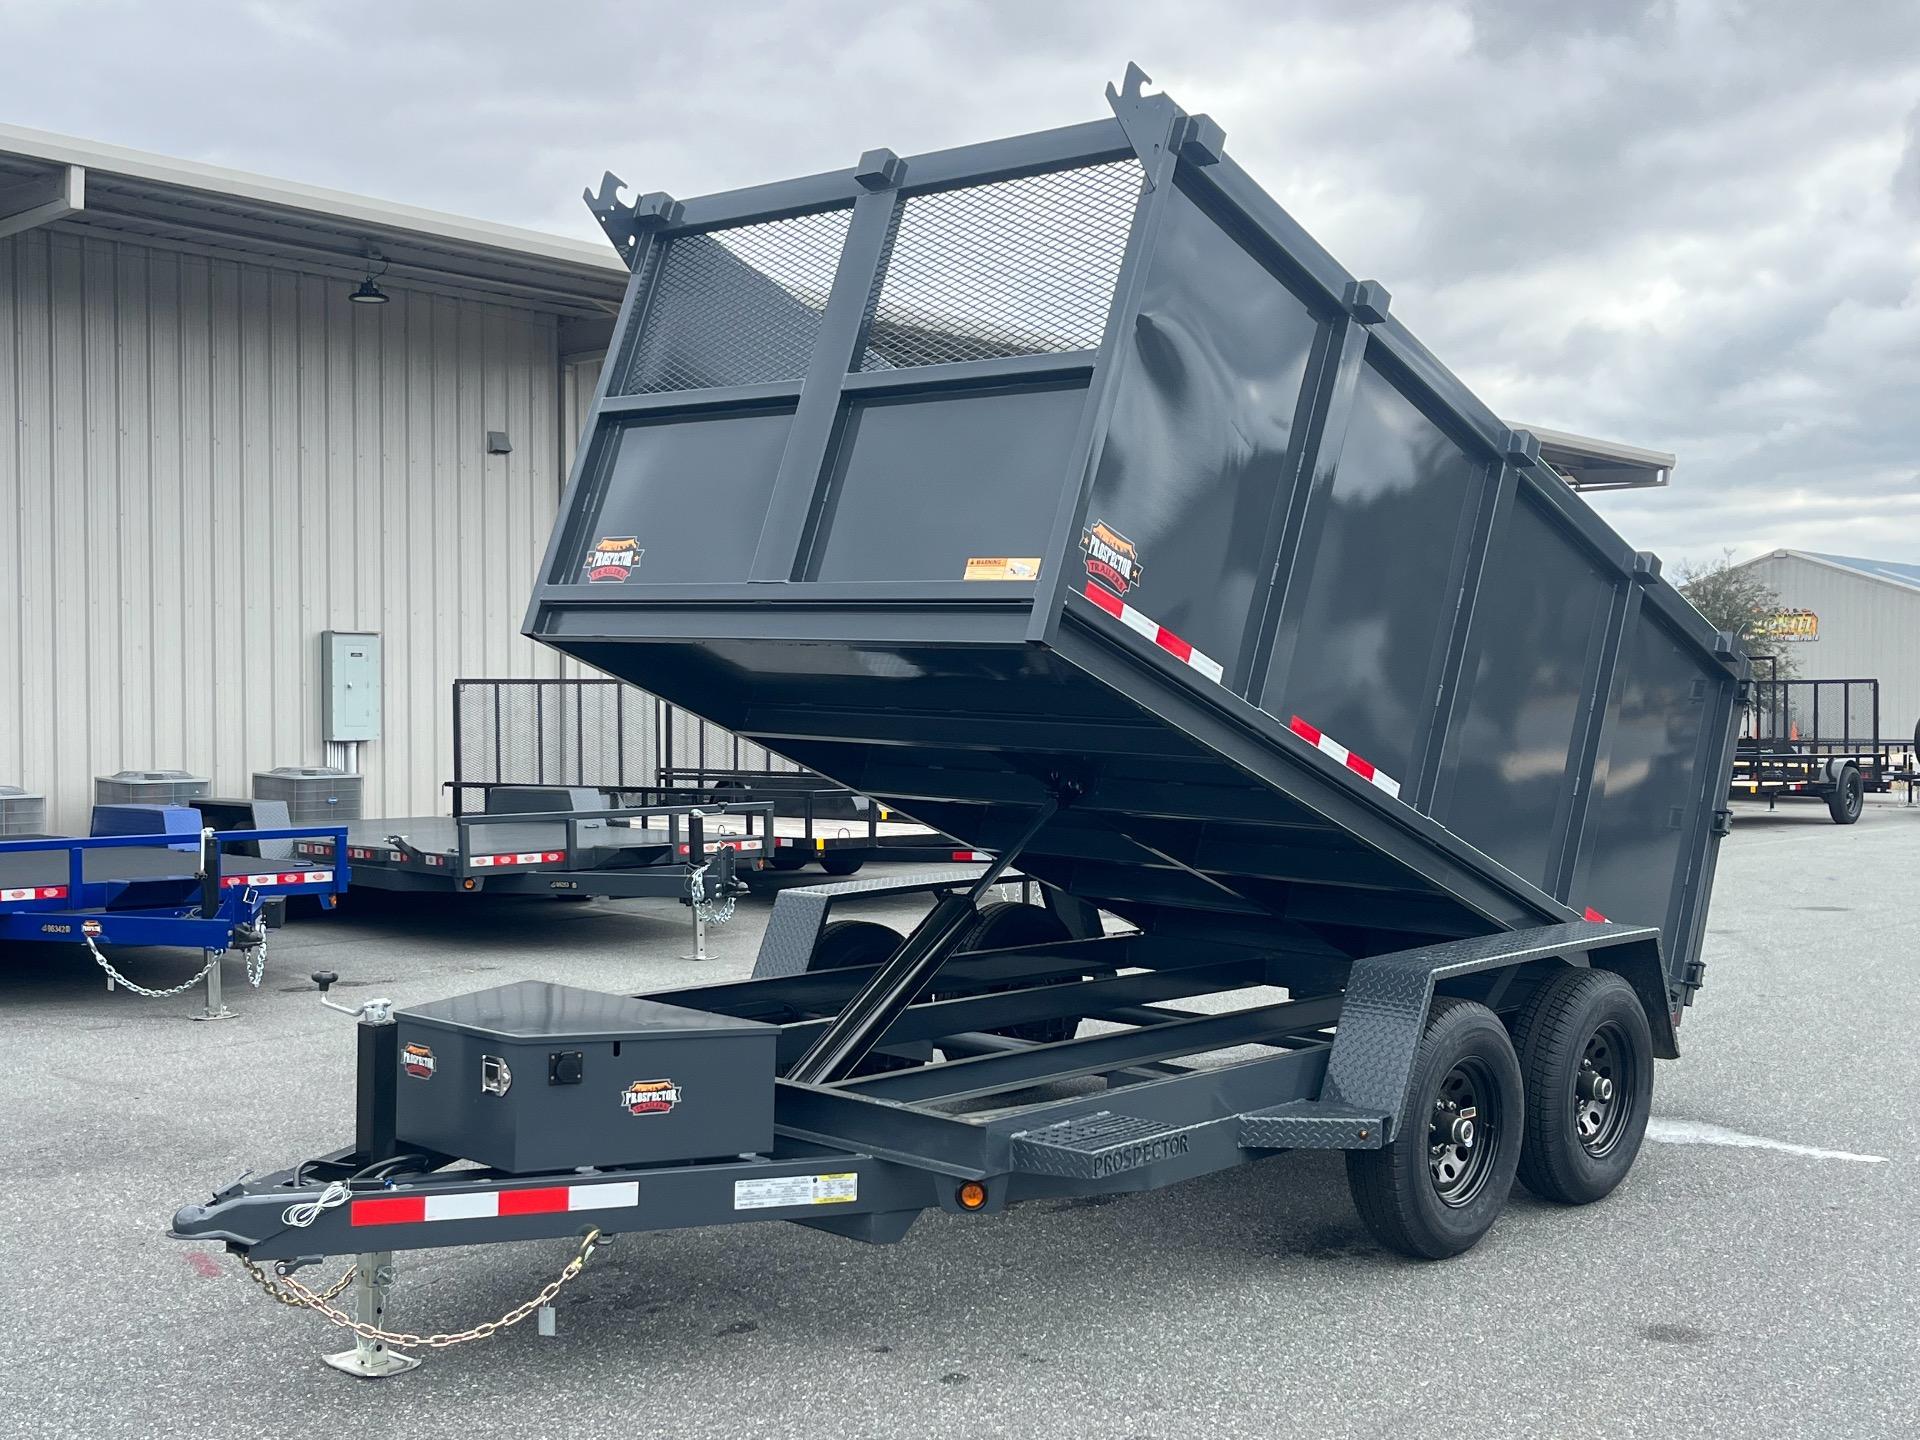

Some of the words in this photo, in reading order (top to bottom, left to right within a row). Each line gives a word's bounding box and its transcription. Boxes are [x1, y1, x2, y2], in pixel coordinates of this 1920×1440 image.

[1088, 535, 1132, 580] PROSPECTOR
[1089, 562, 1125, 591] TRAILERS
[625, 1089, 677, 1104] PROSPECTOR
[1093, 1135, 1189, 1177] PROSPECTOR
